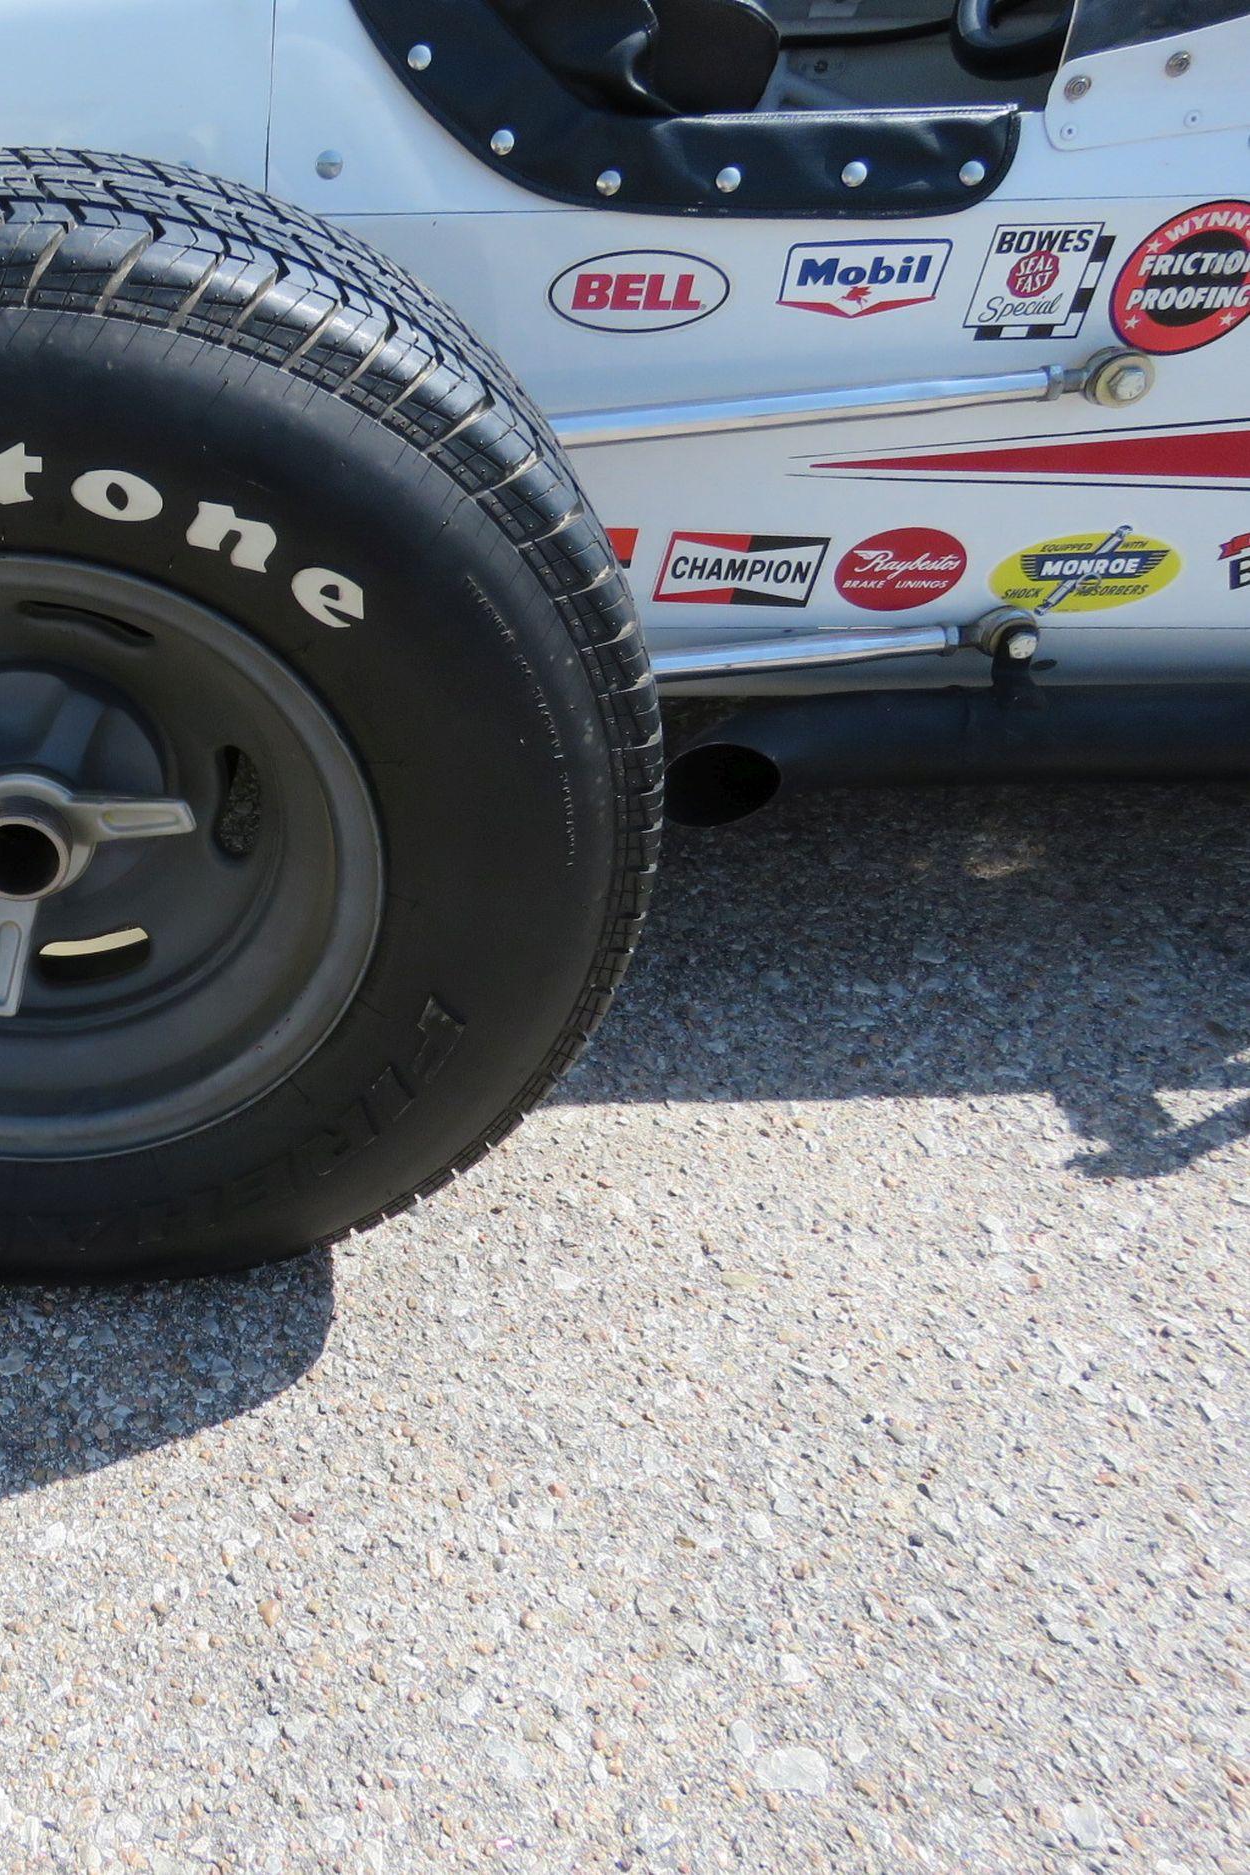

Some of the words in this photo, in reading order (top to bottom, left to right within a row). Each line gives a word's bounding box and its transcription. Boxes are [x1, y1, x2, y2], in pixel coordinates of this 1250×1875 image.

[996, 230, 1092, 253] BOWES
[796, 255, 933, 286] Mobil
[1017, 256, 1054, 276] SEAL
[571, 273, 701, 311] BELL
[1015, 273, 1053, 292] FAST
[978, 294, 1062, 323] Special
[1040, 542, 1093, 553] EQUIPPED
[671, 556, 811, 584] CHAMPION
[853, 549, 960, 581] Raybestos
[1040, 558, 1141, 577] MONROE
[843, 579, 886, 590] BRAKE
[895, 580, 949, 590] LININGS
[1001, 588, 1042, 600] SHOCK
